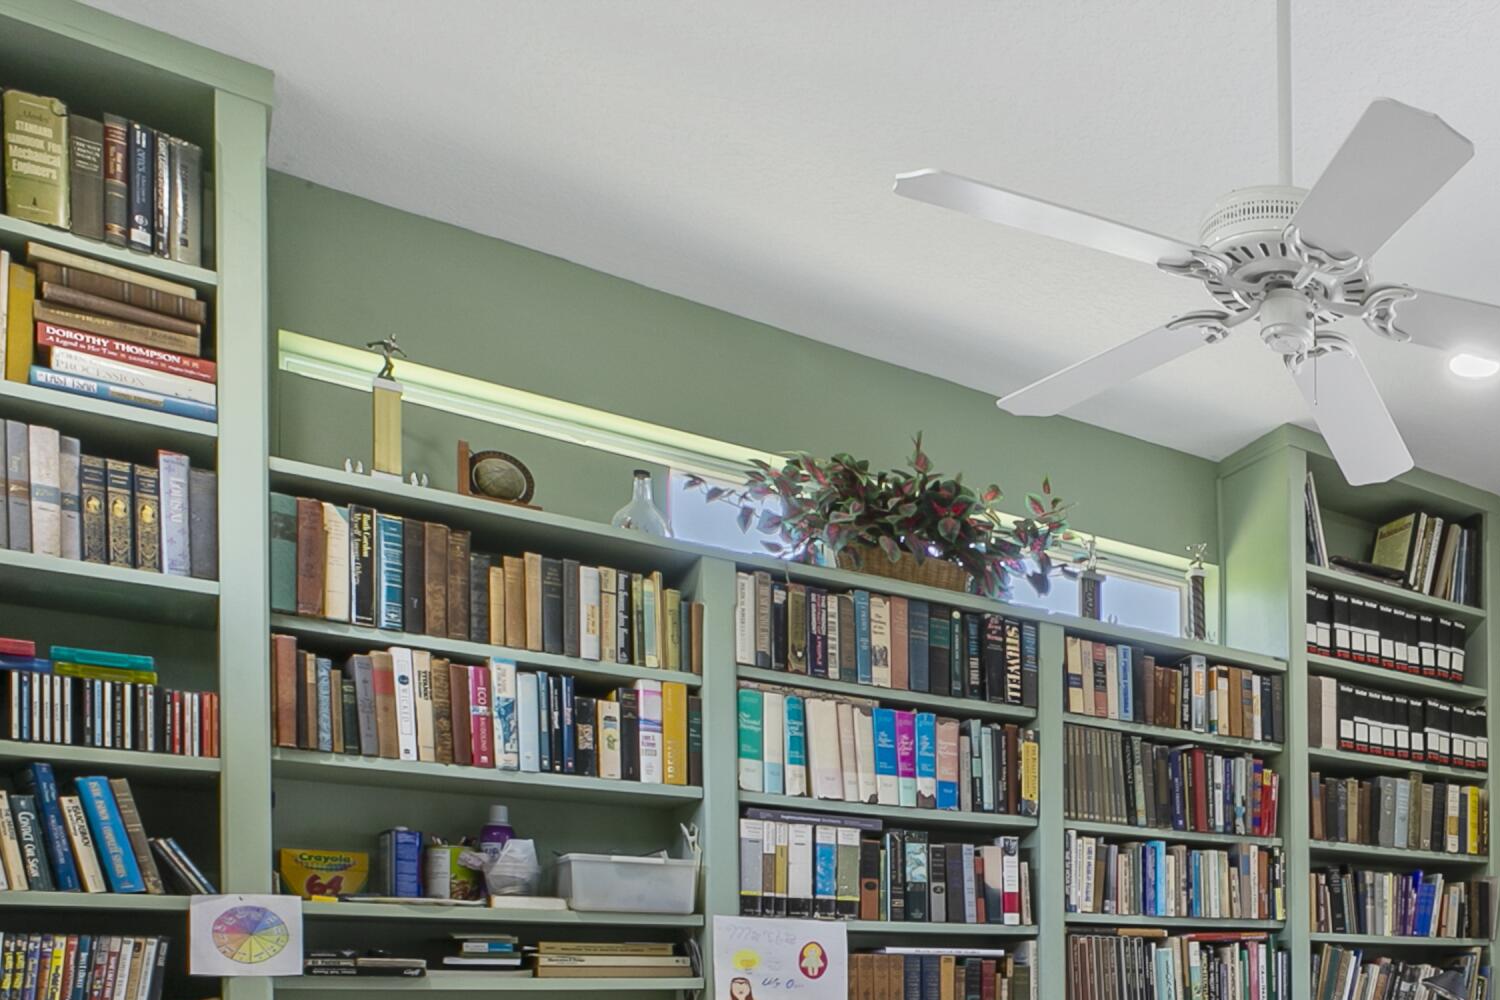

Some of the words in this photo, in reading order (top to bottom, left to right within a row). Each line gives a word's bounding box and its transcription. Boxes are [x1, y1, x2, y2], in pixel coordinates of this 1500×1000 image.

[45, 326, 109, 348] DOROTHY
[113, 341, 181, 364] THOMPSON
[477, 686, 487, 705] ECO
[17, 807, 36, 845] CONTACT
[298, 851, 353, 866] Crayola
[305, 874, 346, 896] 64
[51, 972, 59, 986] Odd
